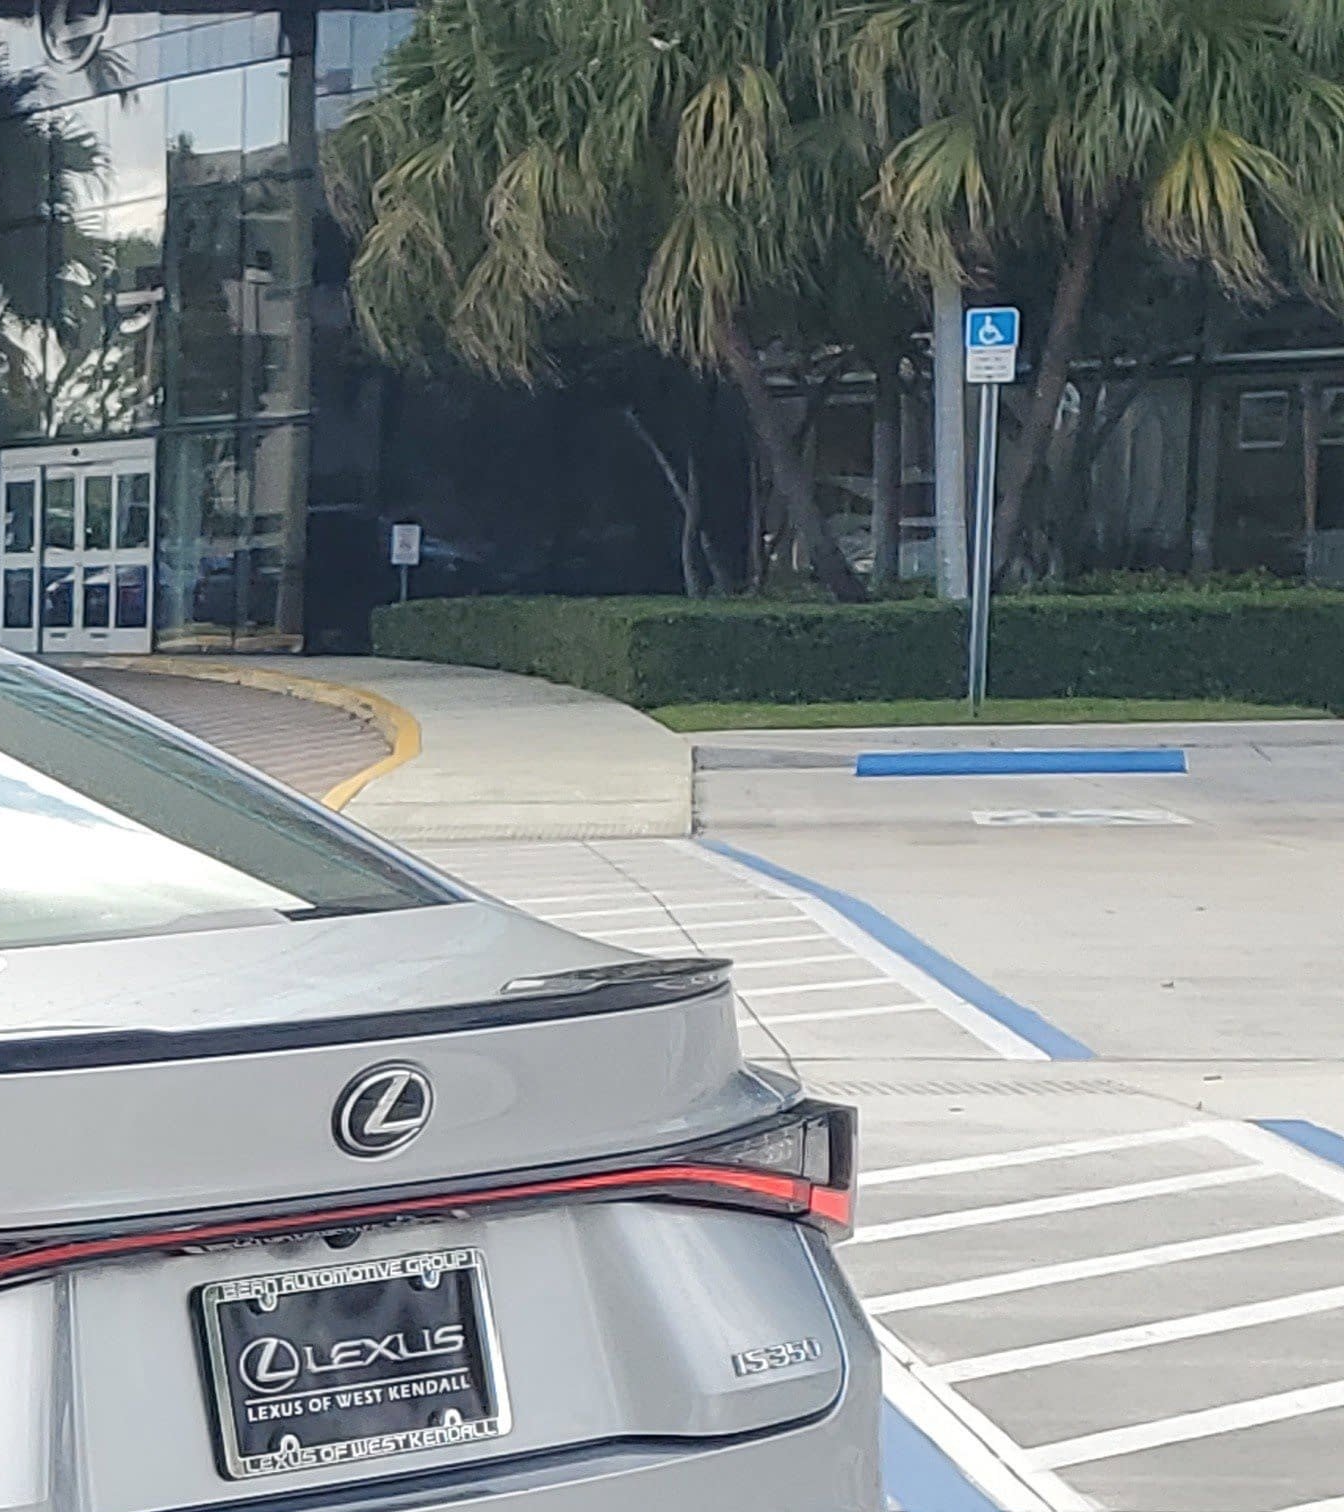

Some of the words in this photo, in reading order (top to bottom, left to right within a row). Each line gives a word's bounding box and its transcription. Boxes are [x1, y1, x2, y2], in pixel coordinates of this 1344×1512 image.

[281, 1261, 403, 1292] AUTOMOTIVE
[405, 1250, 469, 1273] GROUP
[304, 1325, 465, 1373] LEXUS
[247, 1403, 304, 1422] LEXUS
[308, 1396, 332, 1413] OF
[335, 1388, 384, 1409] WEST
[388, 1375, 471, 1401] KENDALL
[246, 1448, 318, 1473] LEXUS
[321, 1444, 348, 1462] OF
[352, 1434, 406, 1457] WEST
[410, 1420, 498, 1447] KENDALL
